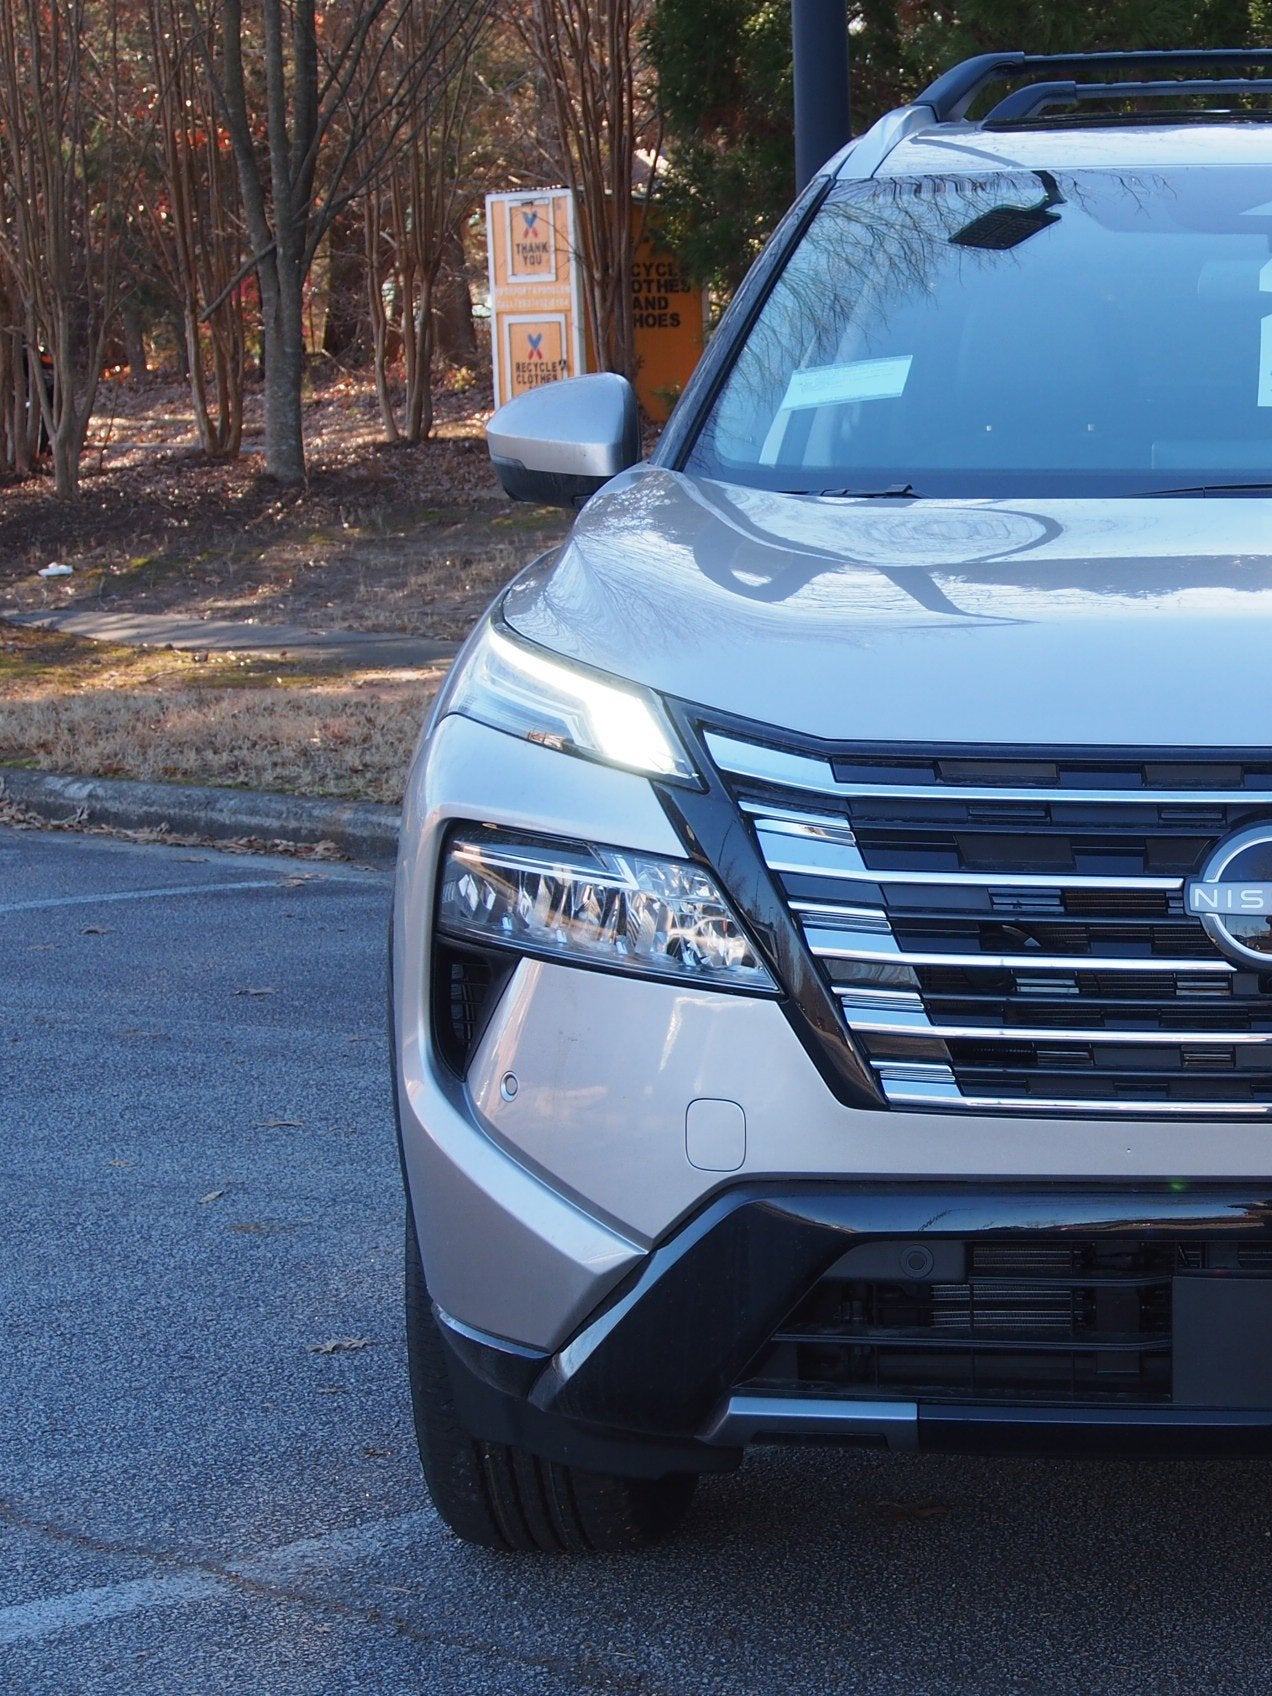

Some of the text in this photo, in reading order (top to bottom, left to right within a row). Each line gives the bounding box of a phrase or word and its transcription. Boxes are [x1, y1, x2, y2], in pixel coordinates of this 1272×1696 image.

[515, 241, 549, 255] THANK
[523, 253, 542, 266] YOU
[631, 279, 691, 294] OTHES
[632, 296, 669, 311] AND
[633, 312, 681, 328] HOES
[515, 361, 557, 373] RECYCLE
[515, 373, 558, 385] CLOTHES
